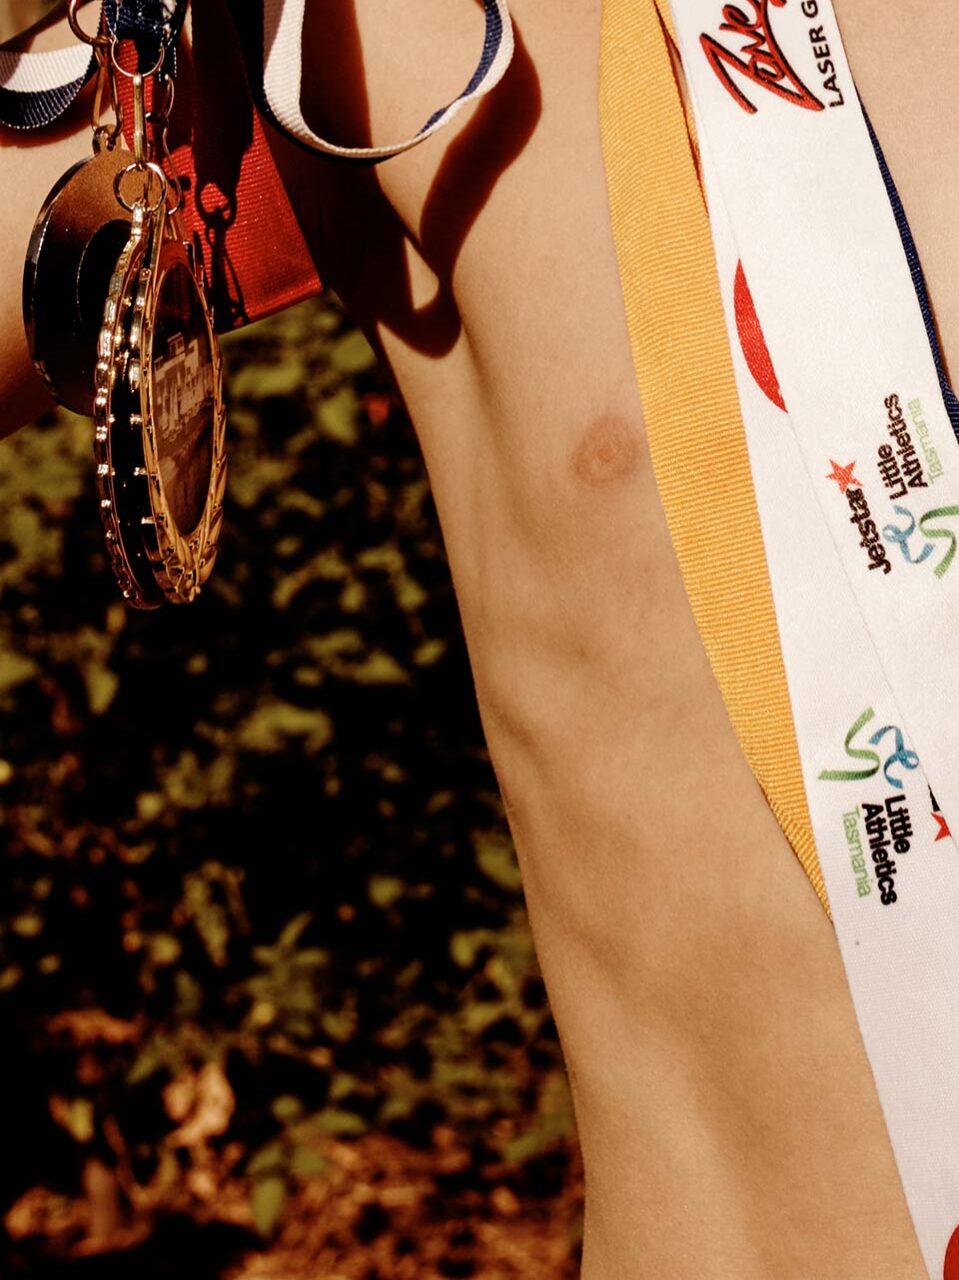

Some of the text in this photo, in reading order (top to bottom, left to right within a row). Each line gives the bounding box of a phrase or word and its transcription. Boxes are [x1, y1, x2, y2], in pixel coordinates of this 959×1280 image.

[808, 25, 844, 108] LASER
[877, 443, 908, 500] Little
[884, 393, 928, 489] Athletics
[907, 398, 944, 484] Tasmania
[845, 488, 892, 574] Jetstar
[842, 805, 873, 898] Tasmania
[861, 803, 898, 906] Athletics
[884, 794, 913, 854] Little
